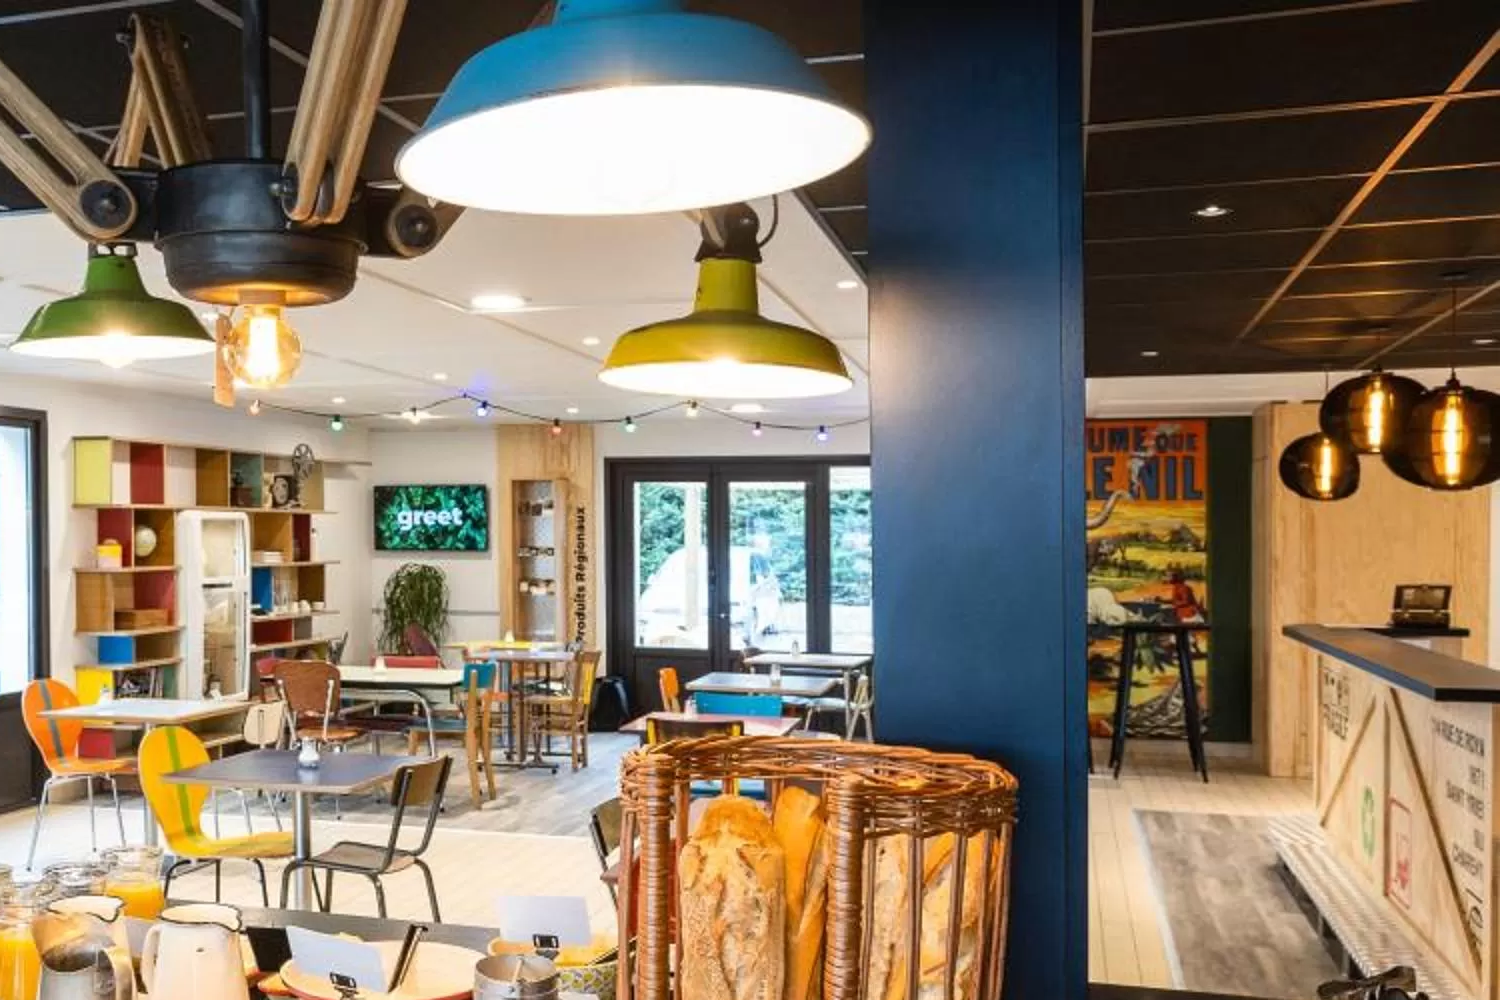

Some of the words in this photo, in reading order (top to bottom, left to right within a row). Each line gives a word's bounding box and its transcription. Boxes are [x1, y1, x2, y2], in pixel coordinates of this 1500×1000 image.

[1087, 427, 1147, 453] UME
[1086, 456, 1115, 500] E
[1128, 456, 1204, 500] NIL
[397, 507, 463, 531] greet
[574, 507, 588, 582] Régionaux
